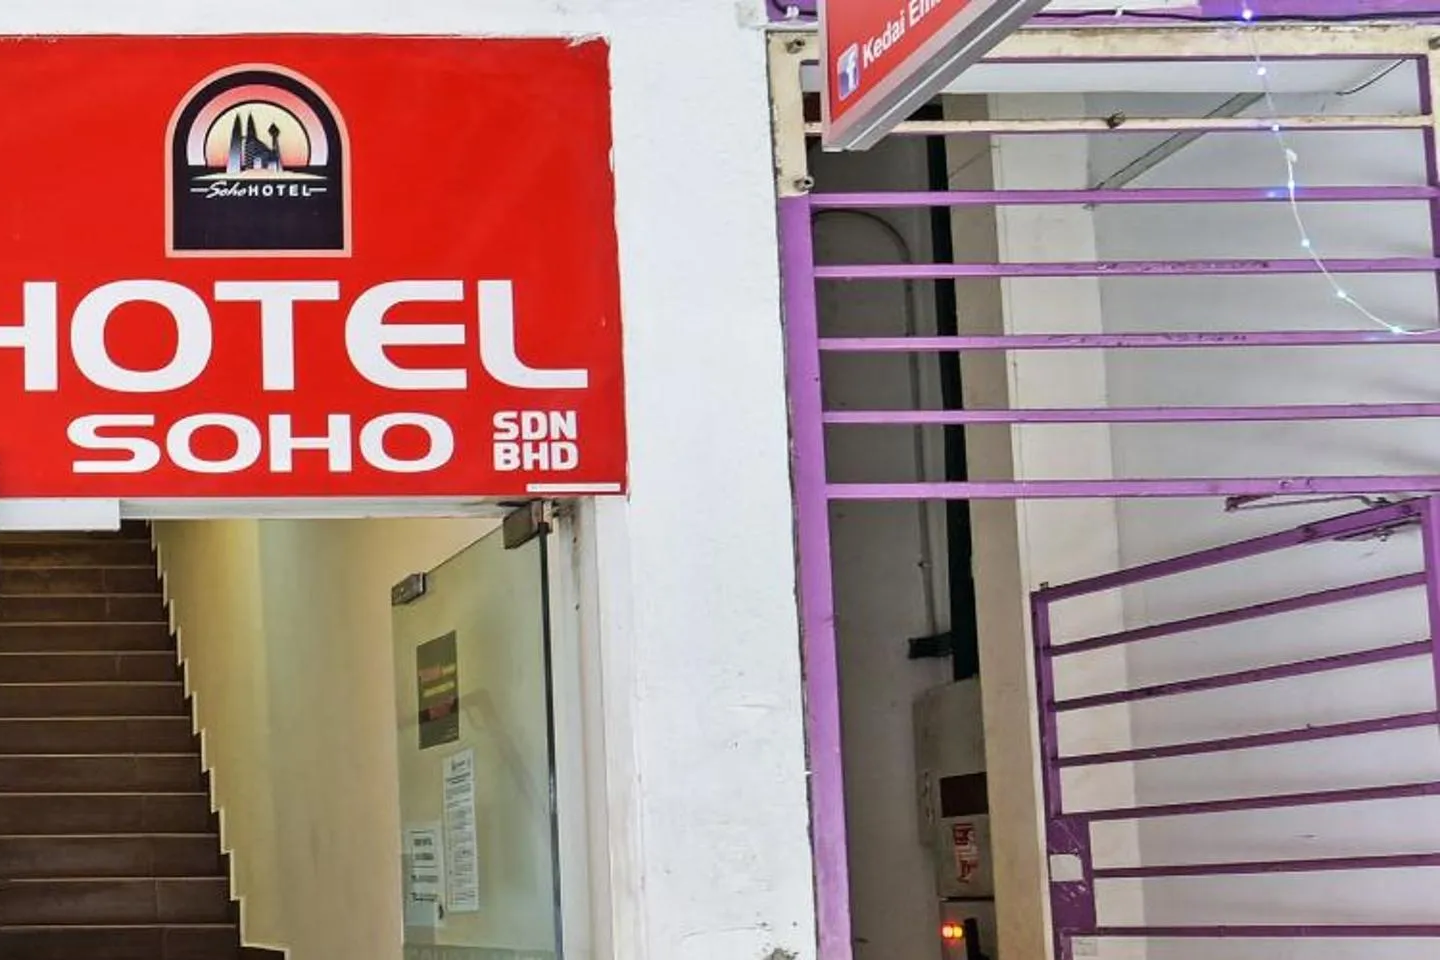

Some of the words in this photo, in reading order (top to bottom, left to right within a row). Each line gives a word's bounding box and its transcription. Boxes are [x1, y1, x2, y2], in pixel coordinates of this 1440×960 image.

[862, 9, 906, 68] Kedai
[248, 184, 311, 197] HOTEL
[492, 411, 578, 440] SDN
[67, 413, 455, 474] SOHO
[492, 442, 579, 472] BHD
